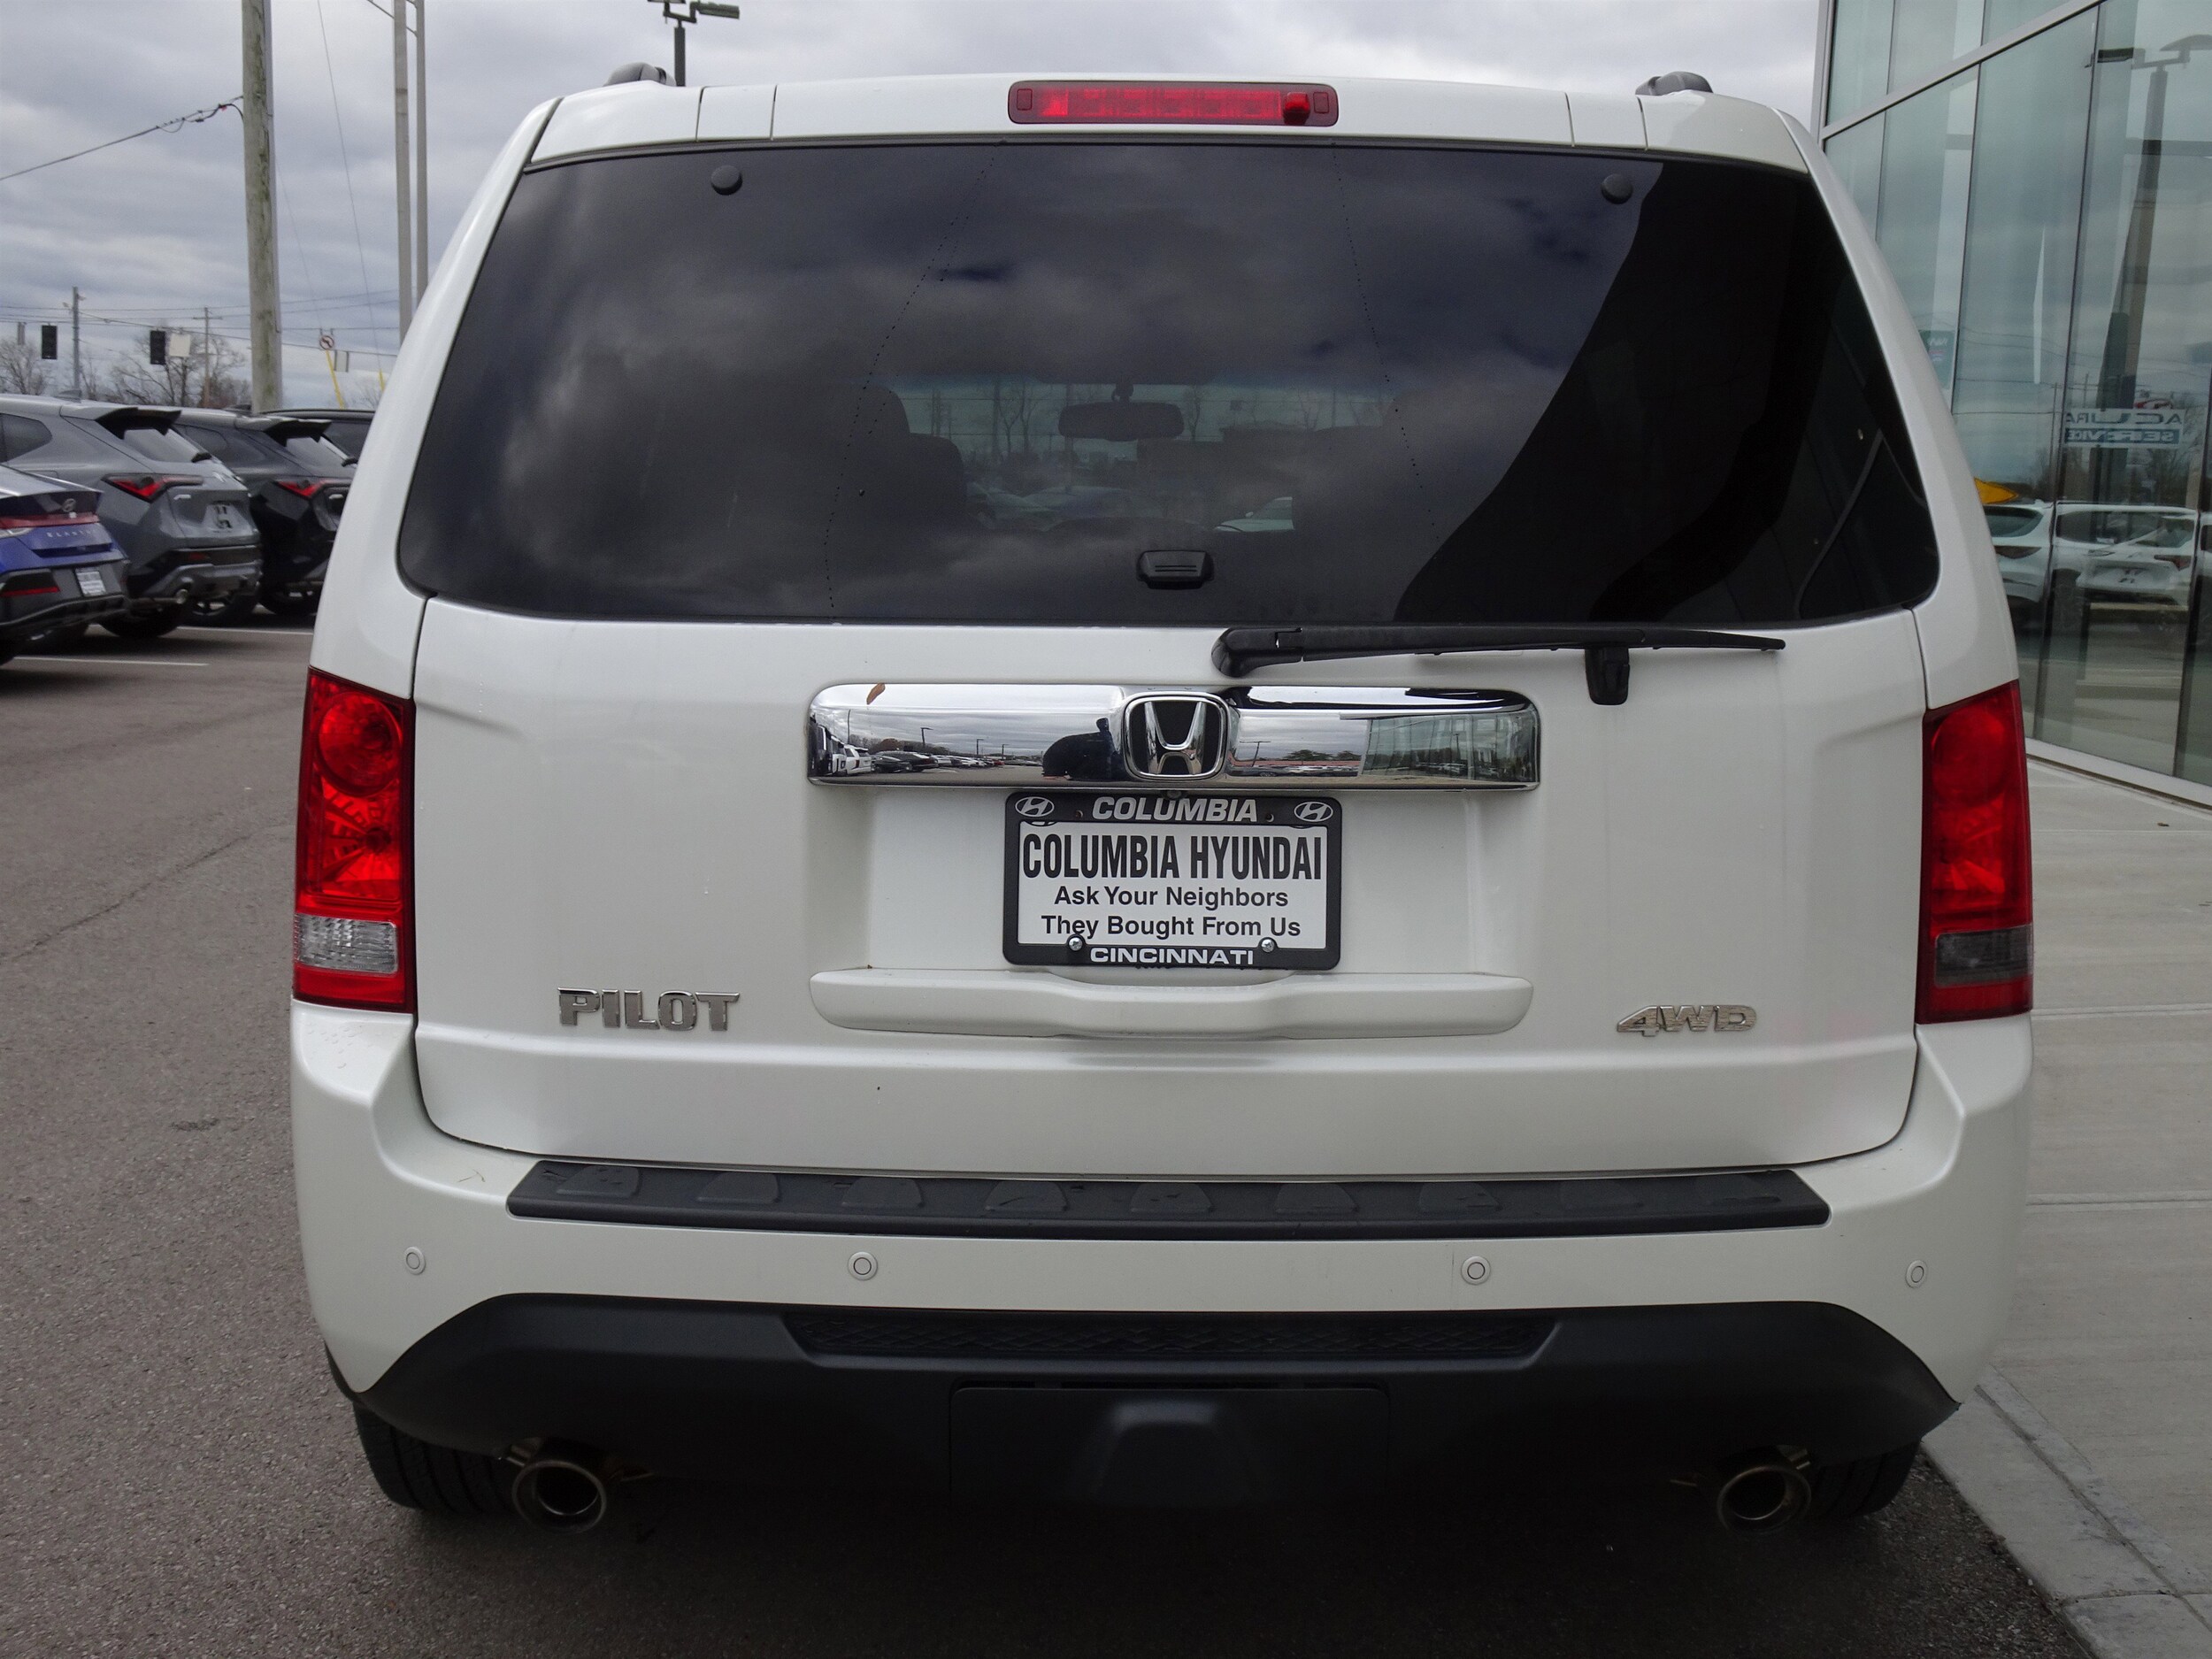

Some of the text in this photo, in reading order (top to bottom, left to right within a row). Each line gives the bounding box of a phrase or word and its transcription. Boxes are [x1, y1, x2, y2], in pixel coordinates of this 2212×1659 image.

[1092, 796, 1257, 822] COLUMBIA
[1023, 833, 1322, 880] COLUMBIA HYUNDAI
[1054, 886, 1289, 910] Ask Your Neighbors
[1041, 916, 1301, 940] They Bought From Us
[1090, 948, 1254, 964] CINCINNATI
[557, 987, 740, 1031] PILOT
[1617, 1004, 1756, 1037] 4WD
